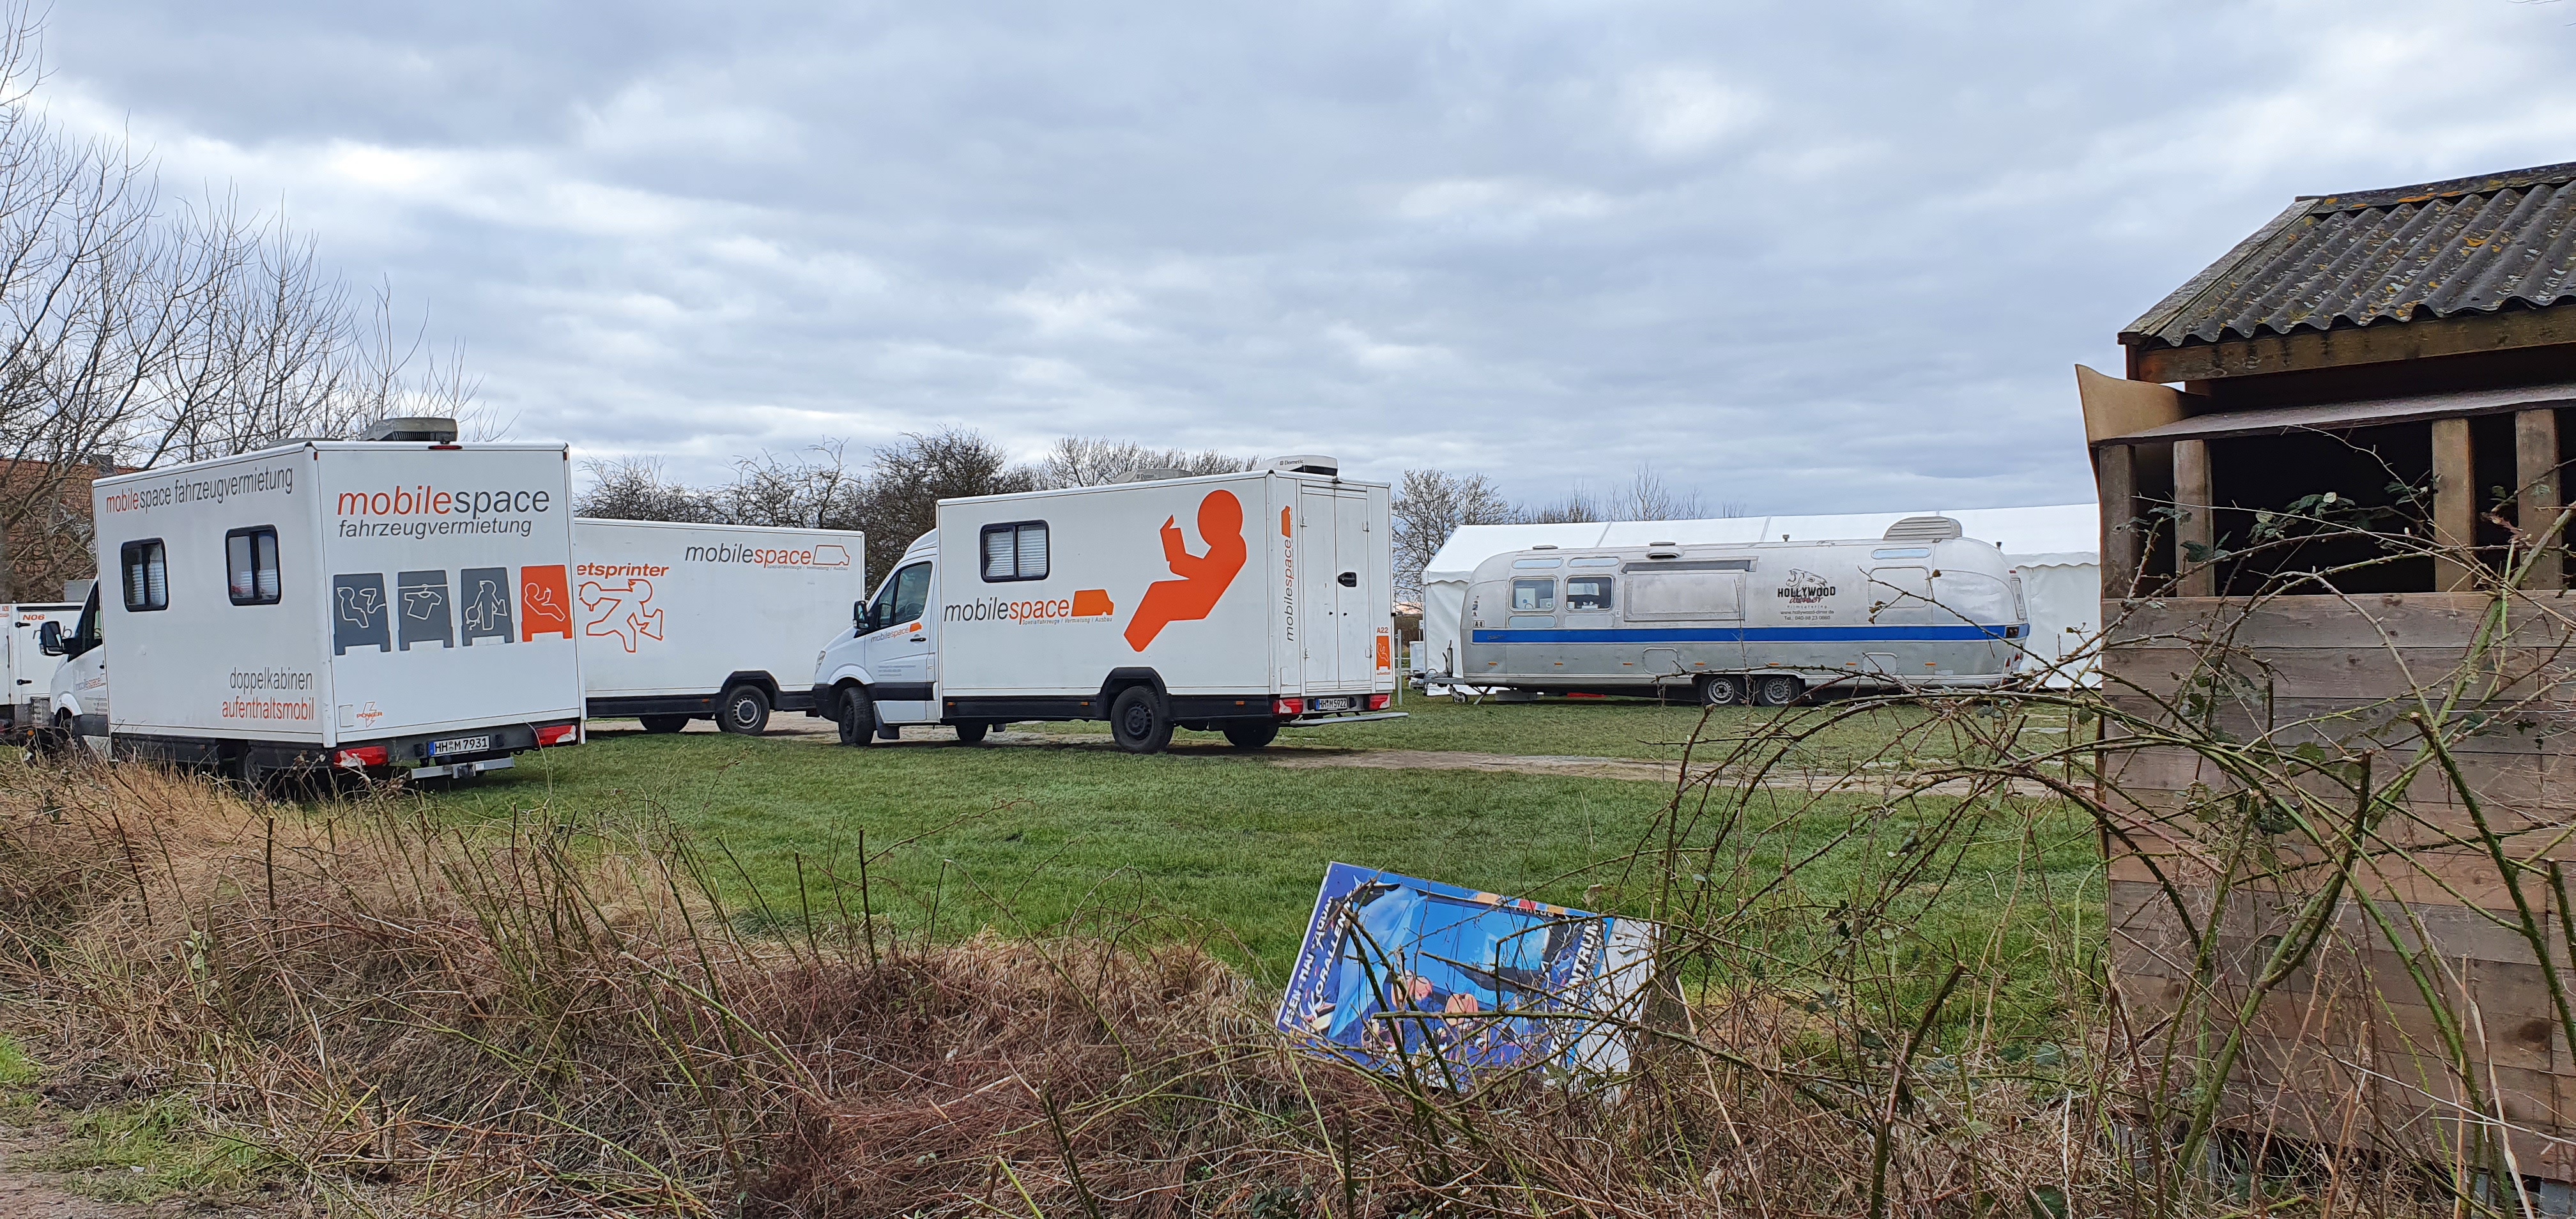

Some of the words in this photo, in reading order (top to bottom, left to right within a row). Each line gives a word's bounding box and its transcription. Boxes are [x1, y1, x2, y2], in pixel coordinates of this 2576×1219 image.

[106, 487, 171, 514] mobilespace
[174, 466, 293, 504] fahrzeugvermietung
[337, 485, 550, 519] mobilespace
[339, 516, 532, 540] fahrzeugvermietung
[684, 542, 811, 569] mobilespace
[576, 562, 670, 579] etsprinter
[1284, 539, 1294, 641] mobilespace
[1777, 586, 1836, 597] HOLLYWOOD
[944, 597, 1070, 625] mobilespace
[871, 627, 909, 643] mobilespace
[229, 666, 313, 695] doppelkabinen
[222, 695, 314, 721] aufenthaltsmobil
